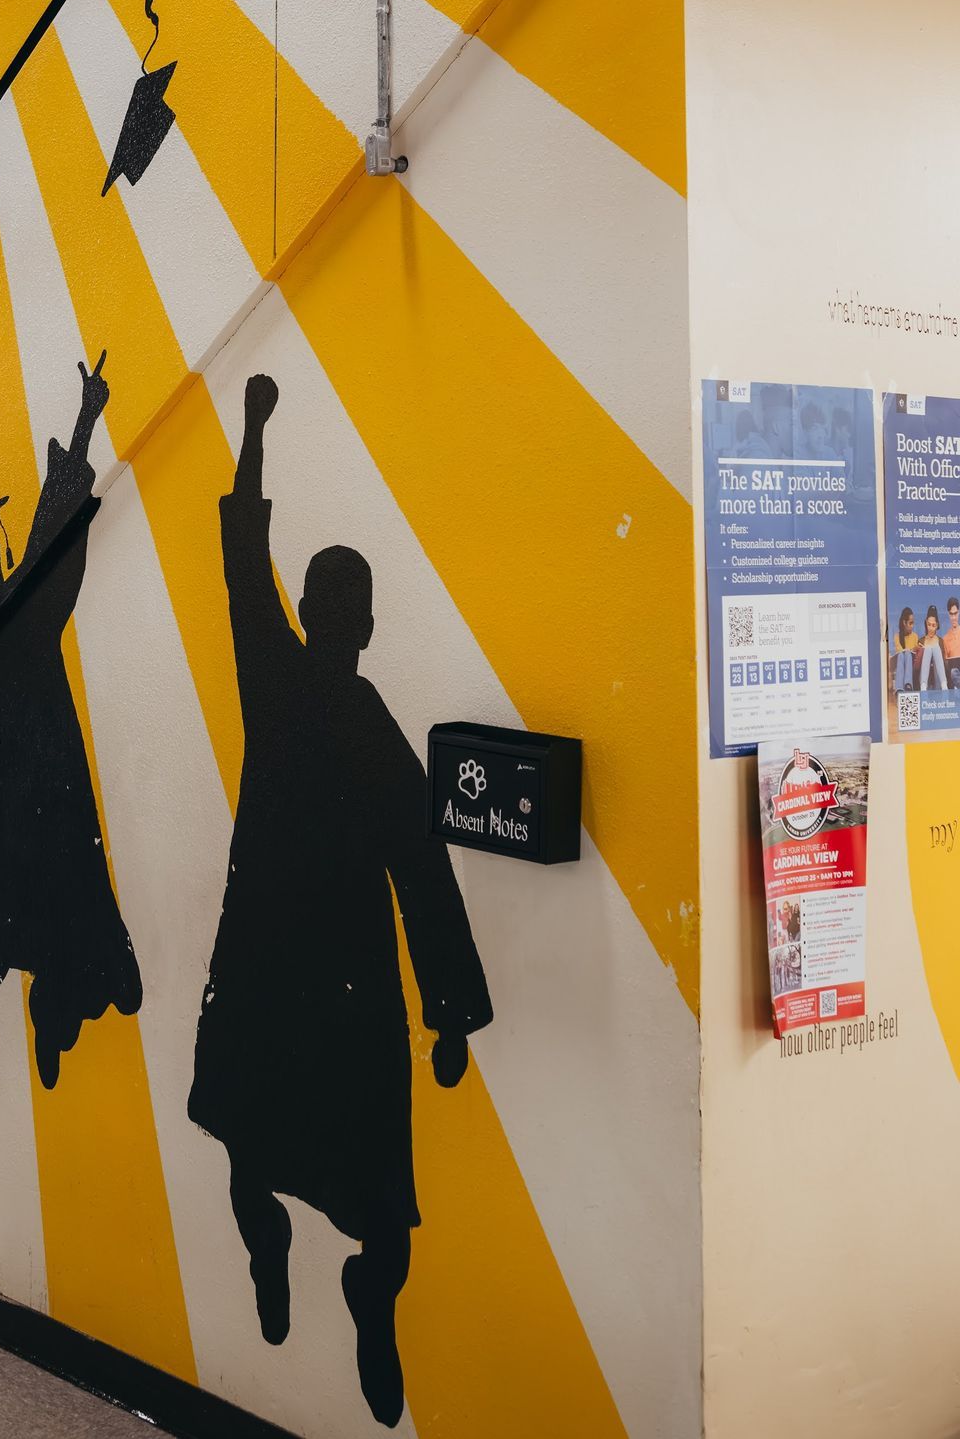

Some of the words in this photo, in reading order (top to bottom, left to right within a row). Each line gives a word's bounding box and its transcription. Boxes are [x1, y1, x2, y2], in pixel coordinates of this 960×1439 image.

[732, 387, 747, 396] SAT
[896, 433, 933, 454] Boost
[935, 435, 960, 456] SAT
[897, 457, 928, 477] With
[931, 458, 960, 478] Offic
[719, 469, 747, 490] The
[751, 470, 784, 491] SAT
[788, 471, 846, 494] provides
[720, 499, 756, 514] more
[760, 494, 792, 514] than
[795, 499, 804, 514] a
[808, 499, 847, 515] score.
[720, 524, 726, 534] It
[727, 523, 749, 534] offers:
[731, 538, 774, 549] Personalized
[775, 540, 796, 549] career
[797, 538, 825, 550] insights
[731, 556, 772, 566] Customized
[773, 555, 797, 567] college
[797, 554, 829, 566] guidance
[732, 572, 773, 584] Scholarship
[774, 571, 819, 584] opportunities
[777, 612, 791, 621] how
[758, 624, 769, 634] the
[770, 623, 784, 633] SAT
[785, 625, 796, 633] can
[783, 670, 788, 680] 8
[799, 669, 804, 679] 6
[822, 667, 830, 677] 14
[838, 666, 844, 676] 2
[853, 665, 859, 675] 6
[732, 673, 742, 684] 23
[750, 673, 758, 682] 13
[767, 671, 772, 681] 4
[777, 795, 810, 812] CARDINAL
[811, 790, 831, 804] VIEW
[442, 799, 485, 833] Absent
[489, 806, 528, 842] Notes
[929, 820, 958, 853] my
[773, 855, 812, 870] CARDINAL
[813, 850, 839, 863] VIEW
[780, 1032, 803, 1058] how
[807, 1022, 837, 1053] other
[840, 1015, 875, 1055] people
[878, 1009, 898, 1040] feel
